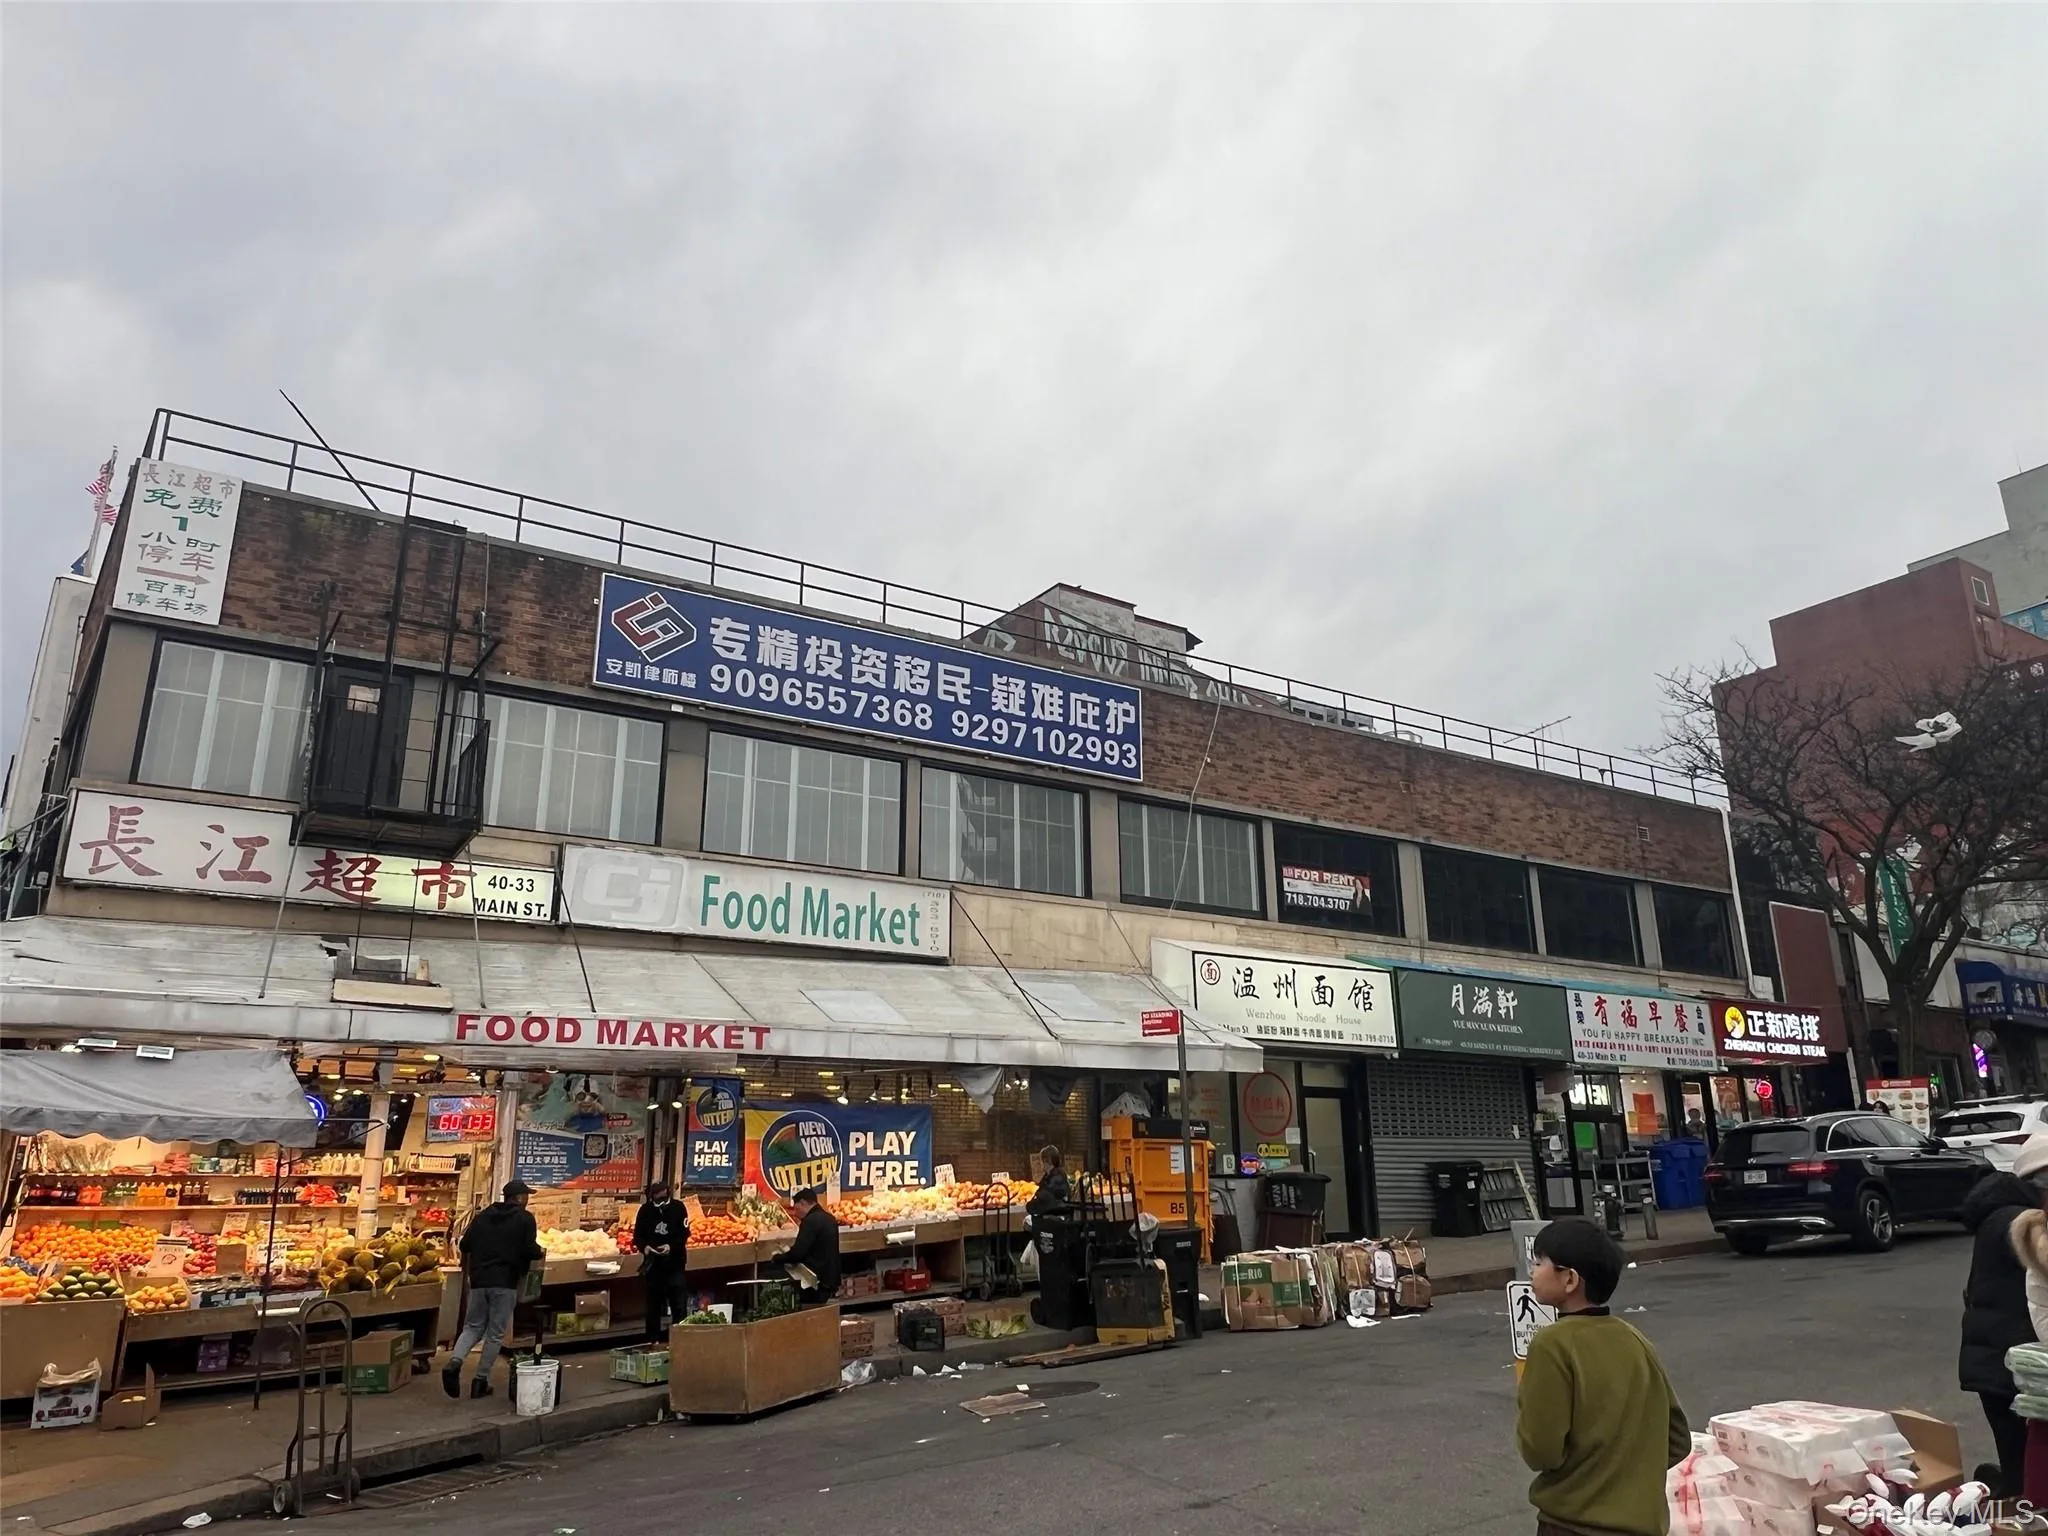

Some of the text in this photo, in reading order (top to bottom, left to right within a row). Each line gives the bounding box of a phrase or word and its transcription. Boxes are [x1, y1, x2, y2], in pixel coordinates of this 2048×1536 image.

[172, 516, 189, 532] 1
[141, 531, 222, 553] 小时
[138, 543, 216, 571] 停车
[144, 579, 197, 599] 百利
[127, 592, 208, 616] 停车场
[605, 658, 697, 689] 安凯律师楼
[710, 664, 1137, 769] 9096557368 9297102993
[487, 874, 535, 893] 40-33
[1294, 867, 1319, 882] FOR
[1323, 871, 1355, 886] RENT
[472, 897, 548, 918] MAIN ST.
[700, 873, 791, 935] Food
[801, 885, 920, 947] Market
[1285, 892, 1350, 911] 718.704.3707
[1232, 966, 1375, 1013] 温州面馆
[1245, 1007, 1362, 1025] Wenzhou Noodle House
[1594, 995, 1689, 1033] 有福早餐
[456, 1013, 771, 1050] FOOD MARKET
[1746, 1010, 1820, 1041] 正新鸡排
[1582, 1028, 1598, 1038] YOU
[1602, 1030, 1611, 1039] FU
[1615, 1031, 1640, 1041] HAPPY
[1644, 1033, 1689, 1045] BREAKFAST
[1724, 1038, 1766, 1053] ZHENGXIN
[1767, 1042, 1801, 1055] CHICKEN
[1802, 1044, 1828, 1057] STEAK
[440, 1114, 494, 1130] 60 133
[799, 1121, 827, 1137] NEW
[695, 1140, 729, 1153] PLAY
[800, 1136, 834, 1158] YORK
[849, 1131, 917, 1155] PLAY
[693, 1154, 733, 1167] HERE.
[849, 1160, 927, 1187] HERE.
[1170, 1202, 1184, 1214] B5
